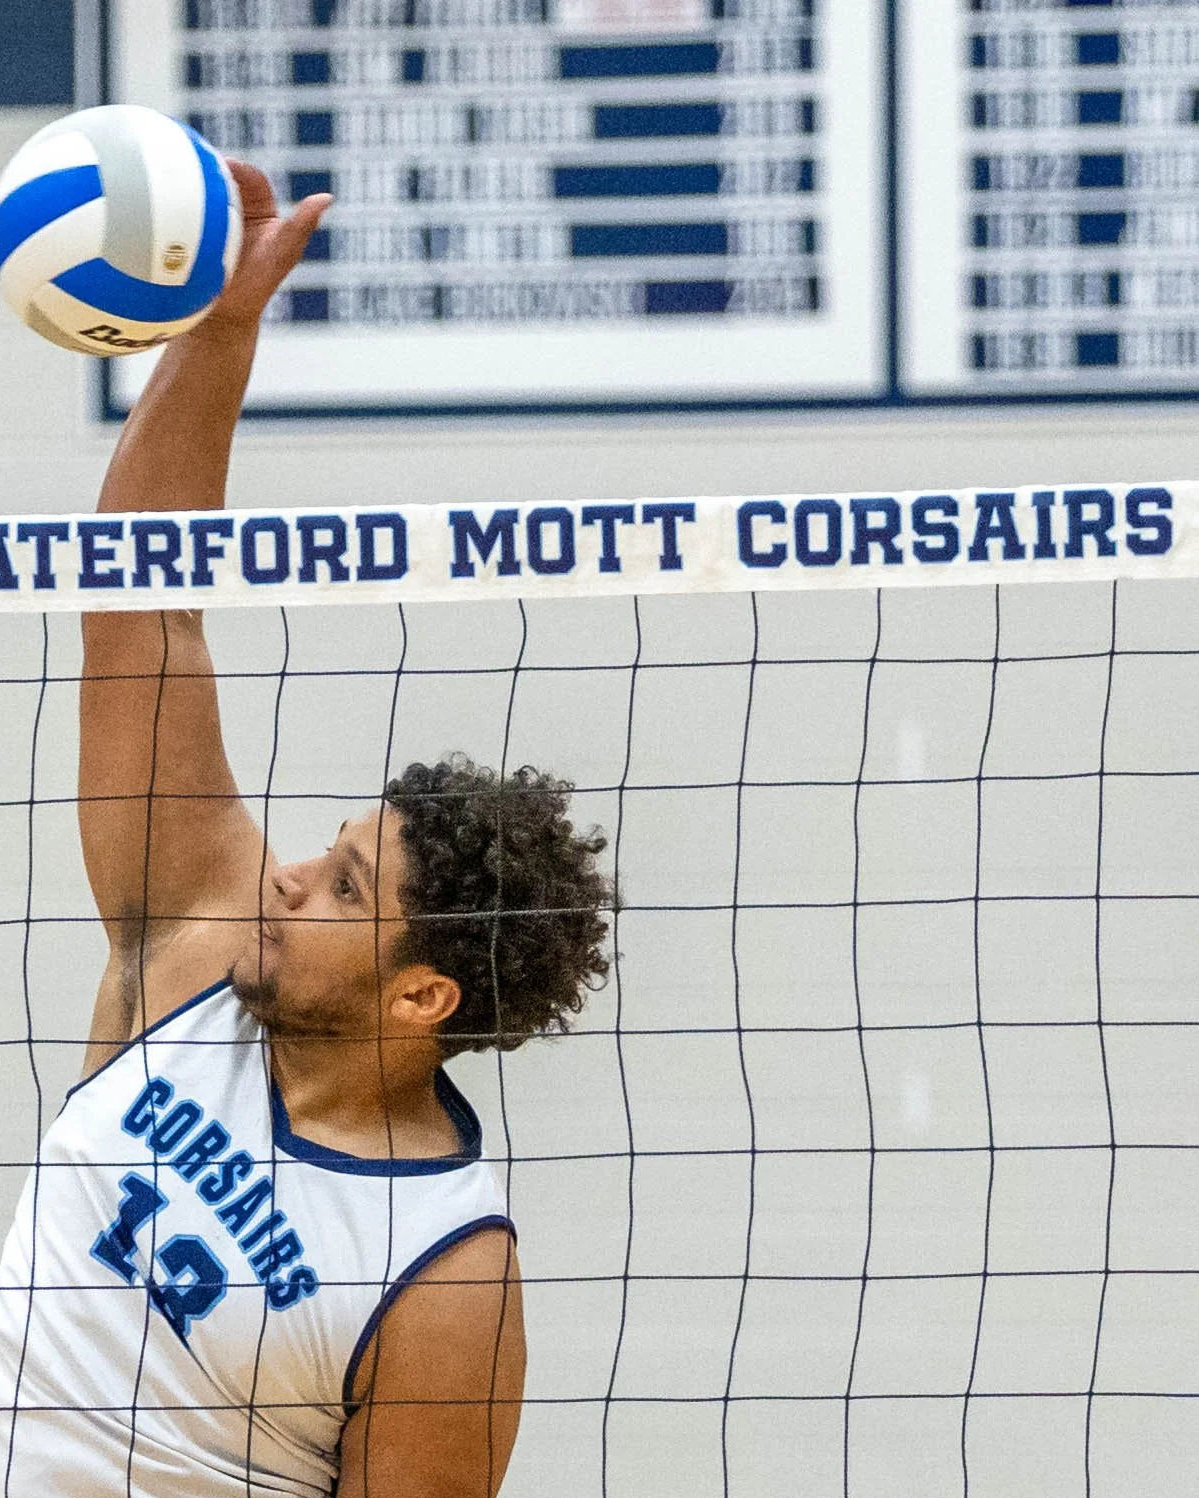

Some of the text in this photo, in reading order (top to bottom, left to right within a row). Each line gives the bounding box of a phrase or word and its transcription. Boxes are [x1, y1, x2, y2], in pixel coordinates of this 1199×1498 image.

[449, 502, 696, 579] MOTT
[738, 487, 1173, 568] CORSAIRS
[121, 1075, 319, 1312] CORSAIRS
